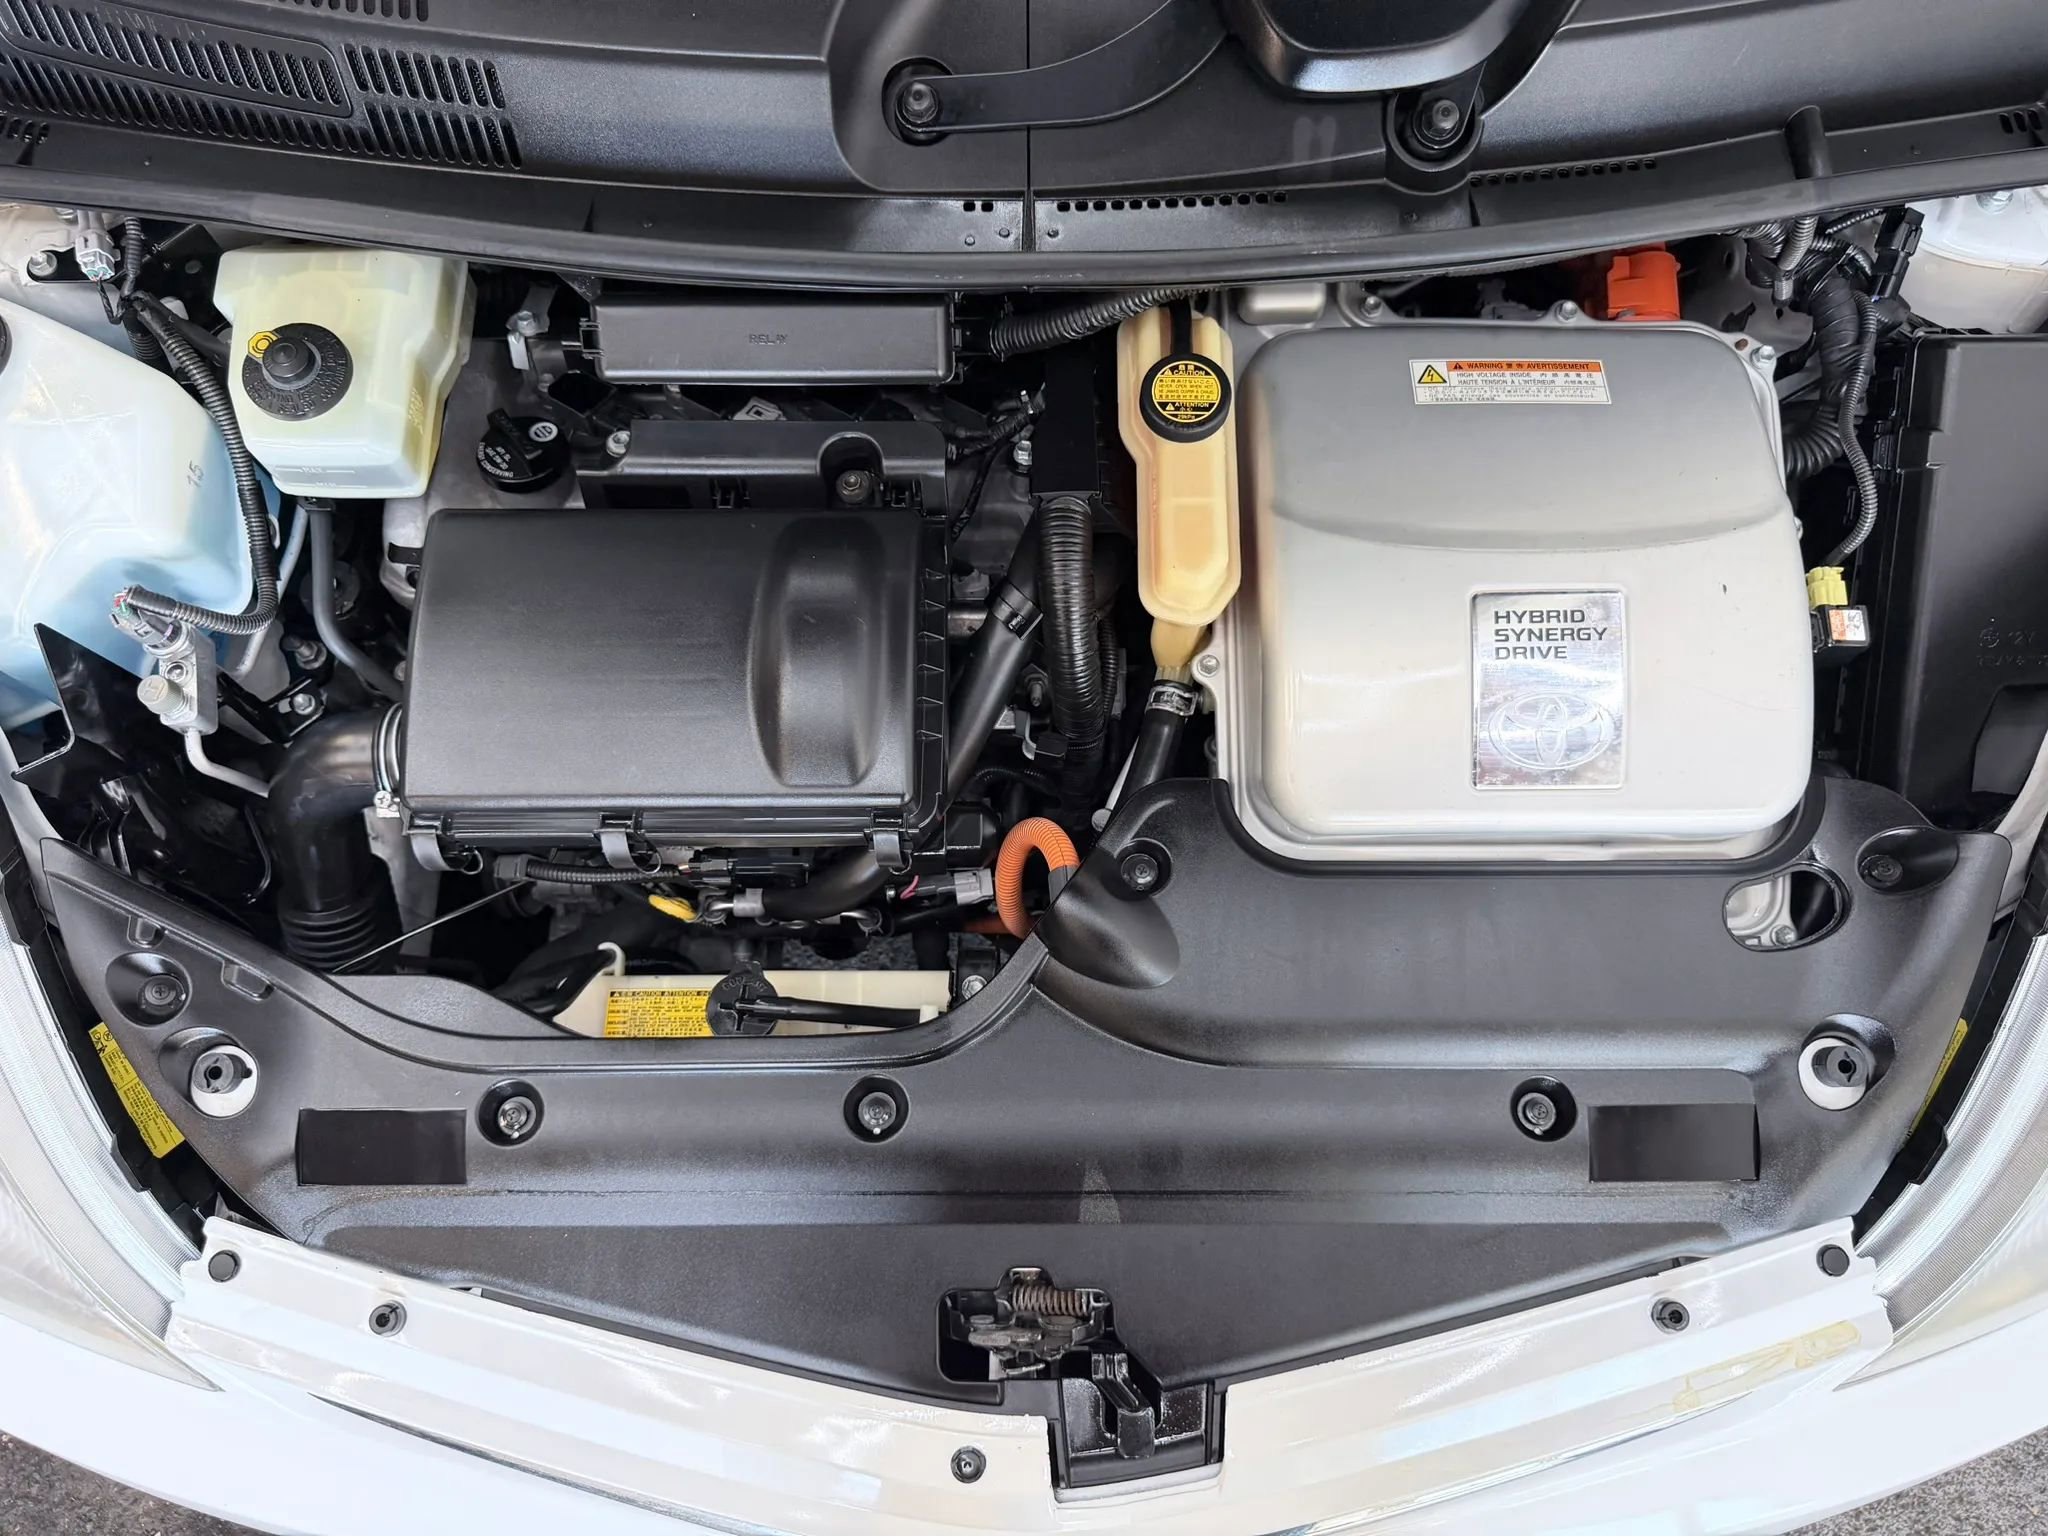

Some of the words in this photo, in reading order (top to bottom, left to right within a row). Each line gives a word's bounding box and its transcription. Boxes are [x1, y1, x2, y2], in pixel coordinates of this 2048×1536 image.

[749, 333, 788, 345] RELAY
[480, 459, 514, 478] CONSERVING
[1494, 609, 1586, 625] HYBRID
[1494, 627, 1608, 642] SYNERGY
[1495, 645, 1568, 661] DRIVE
